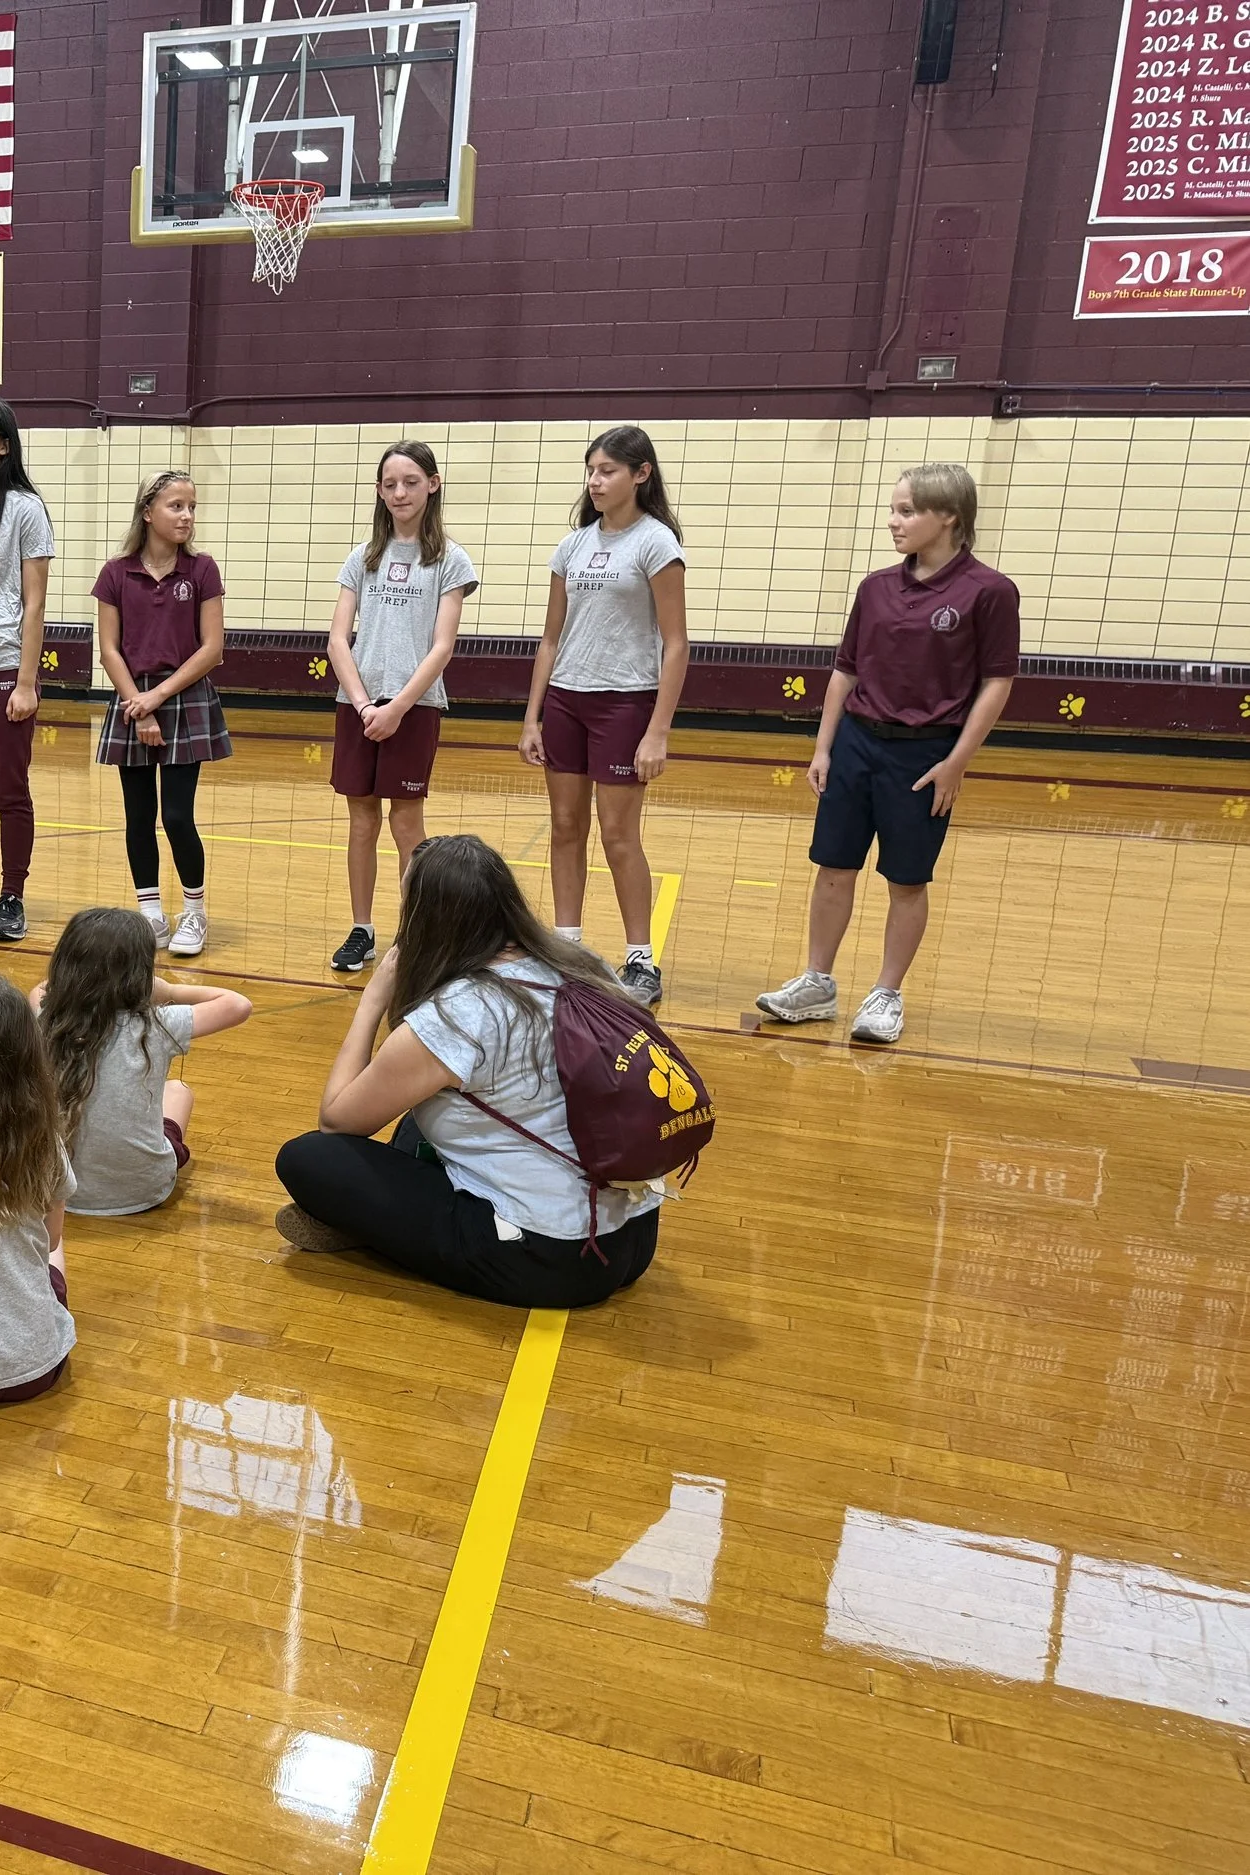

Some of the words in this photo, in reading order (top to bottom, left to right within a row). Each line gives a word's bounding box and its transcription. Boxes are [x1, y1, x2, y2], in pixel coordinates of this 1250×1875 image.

[1144, 7, 1199, 28] 2024
[1204, 4, 1229, 24] B.
[1236, 1, 1250, 21] S
[1140, 33, 1195, 54] 2024
[1200, 32, 1226, 51] R.
[1136, 58, 1191, 79] 2024
[1197, 57, 1220, 76] Z.
[1131, 85, 1186, 104] 2024
[1192, 84, 1203, 92] M.
[1129, 110, 1183, 129] 2025
[1189, 109, 1214, 127] R.
[1126, 134, 1179, 154] 2025
[1187, 133, 1210, 151] C.
[1126, 157, 1179, 178] 2025
[1187, 157, 1210, 174] C.
[1122, 182, 1176, 201] 2025
[1185, 181, 1195, 189] M.
[1115, 248, 1224, 285] 2018
[1088, 290, 1112, 301] Boys
[1113, 290, 1130, 299] 7th
[1132, 288, 1162, 298] Grade
[1163, 288, 1187, 298] State
[1189, 287, 1246, 298] Runner-Up
[578, 570, 620, 579] Benedict
[368, 584, 380, 593] St.
[577, 582, 604, 590] PREP
[615, 1054, 632, 1072] ST.
[660, 1103, 716, 1141] BENGALS
